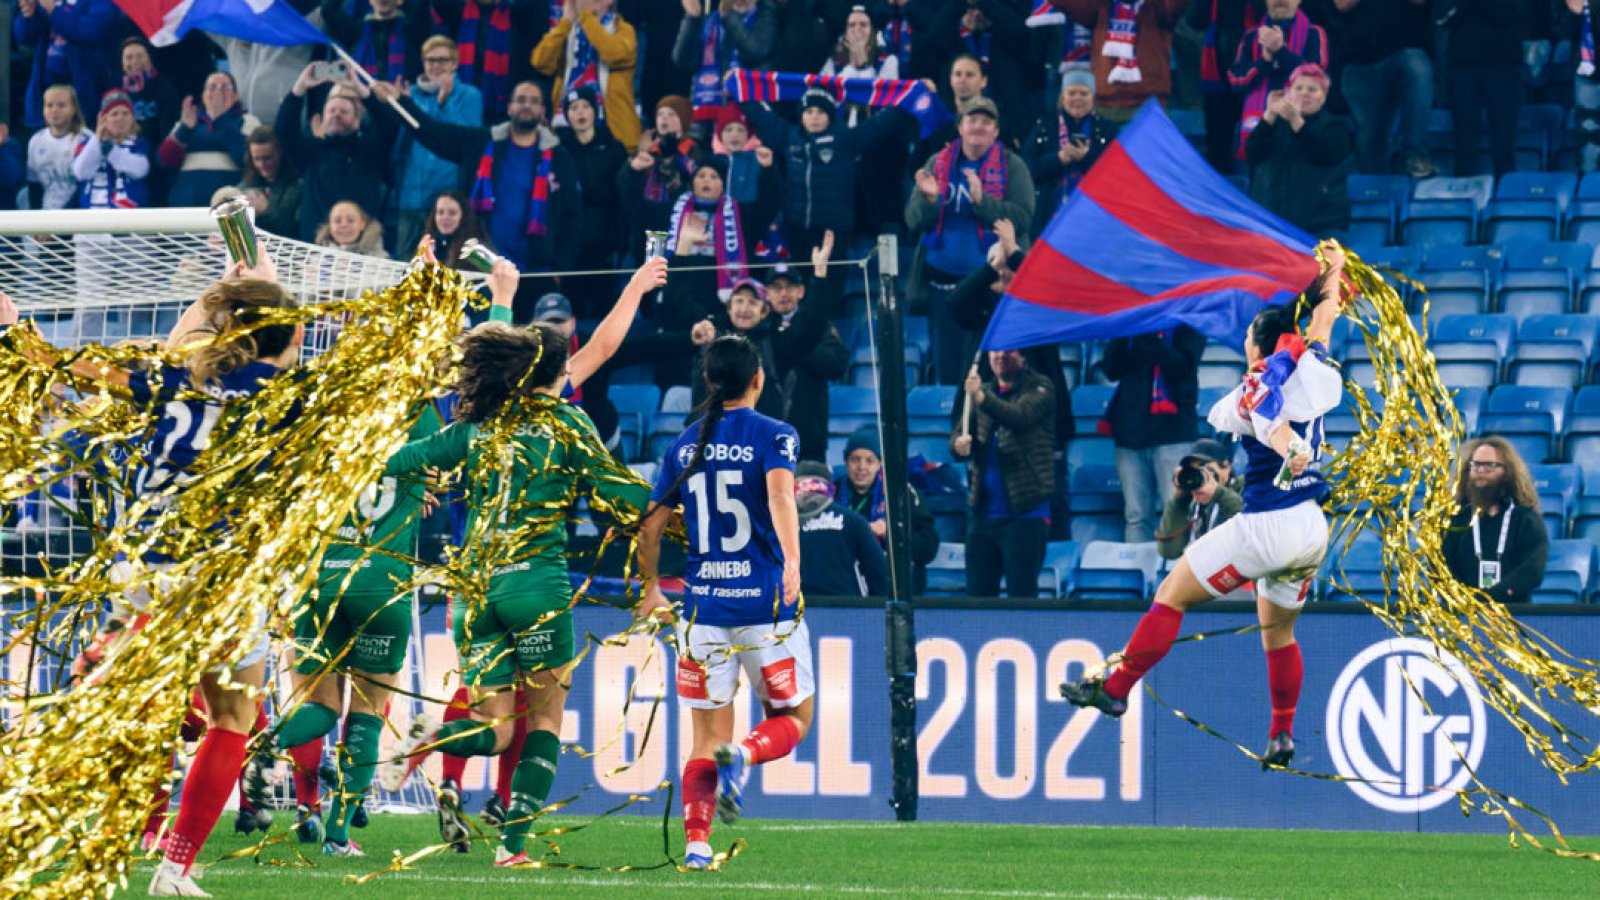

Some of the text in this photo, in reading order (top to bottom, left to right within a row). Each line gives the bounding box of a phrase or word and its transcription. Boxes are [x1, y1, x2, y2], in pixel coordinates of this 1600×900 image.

[703, 443, 754, 462] OBOS
[687, 469, 752, 555] 15
[713, 587, 762, 598] rasisme
[915, 637, 1142, 801] 2021
[1340, 654, 1472, 797] NFF
